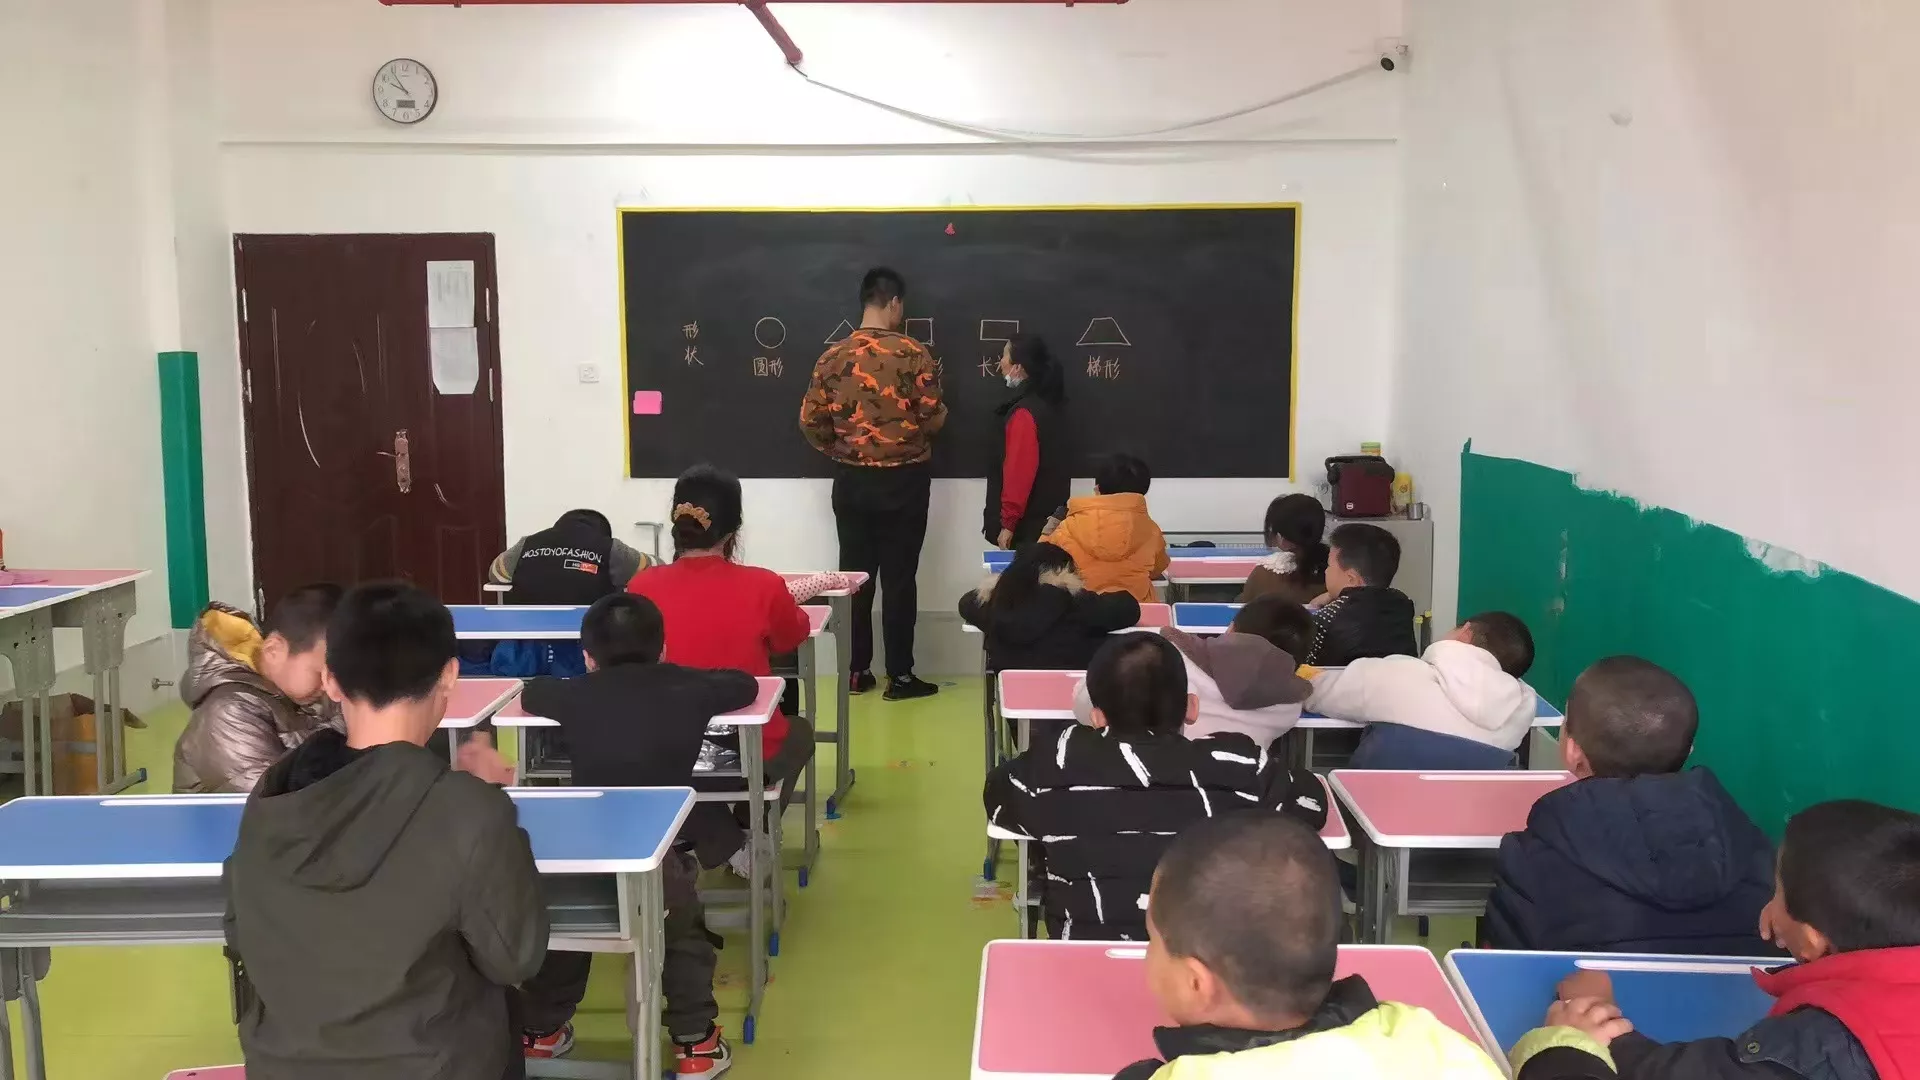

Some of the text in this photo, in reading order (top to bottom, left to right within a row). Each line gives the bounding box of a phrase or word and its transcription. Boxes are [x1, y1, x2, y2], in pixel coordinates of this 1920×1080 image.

[682, 320, 704, 366] 形状
[753, 357, 783, 378] 圆形
[1086, 355, 1121, 380] 梯形
